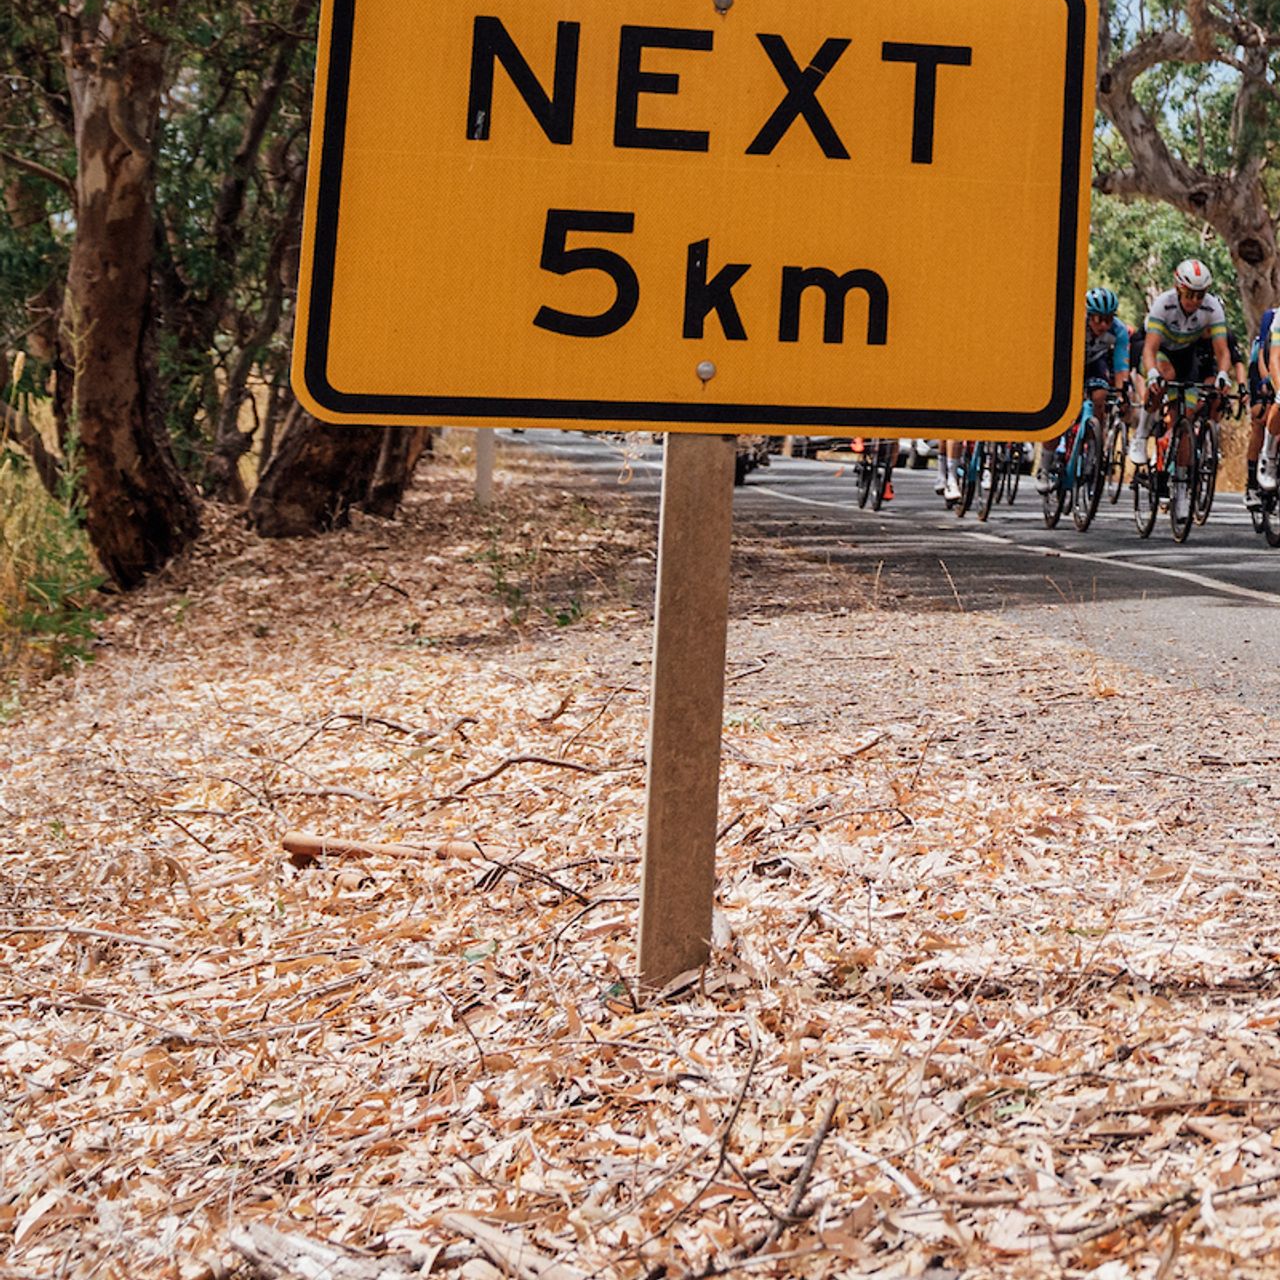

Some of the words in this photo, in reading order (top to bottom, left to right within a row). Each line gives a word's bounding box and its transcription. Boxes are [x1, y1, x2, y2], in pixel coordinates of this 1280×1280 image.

[466, 15, 972, 164] NEXT
[533, 208, 639, 338] 5
[683, 238, 889, 345] km
